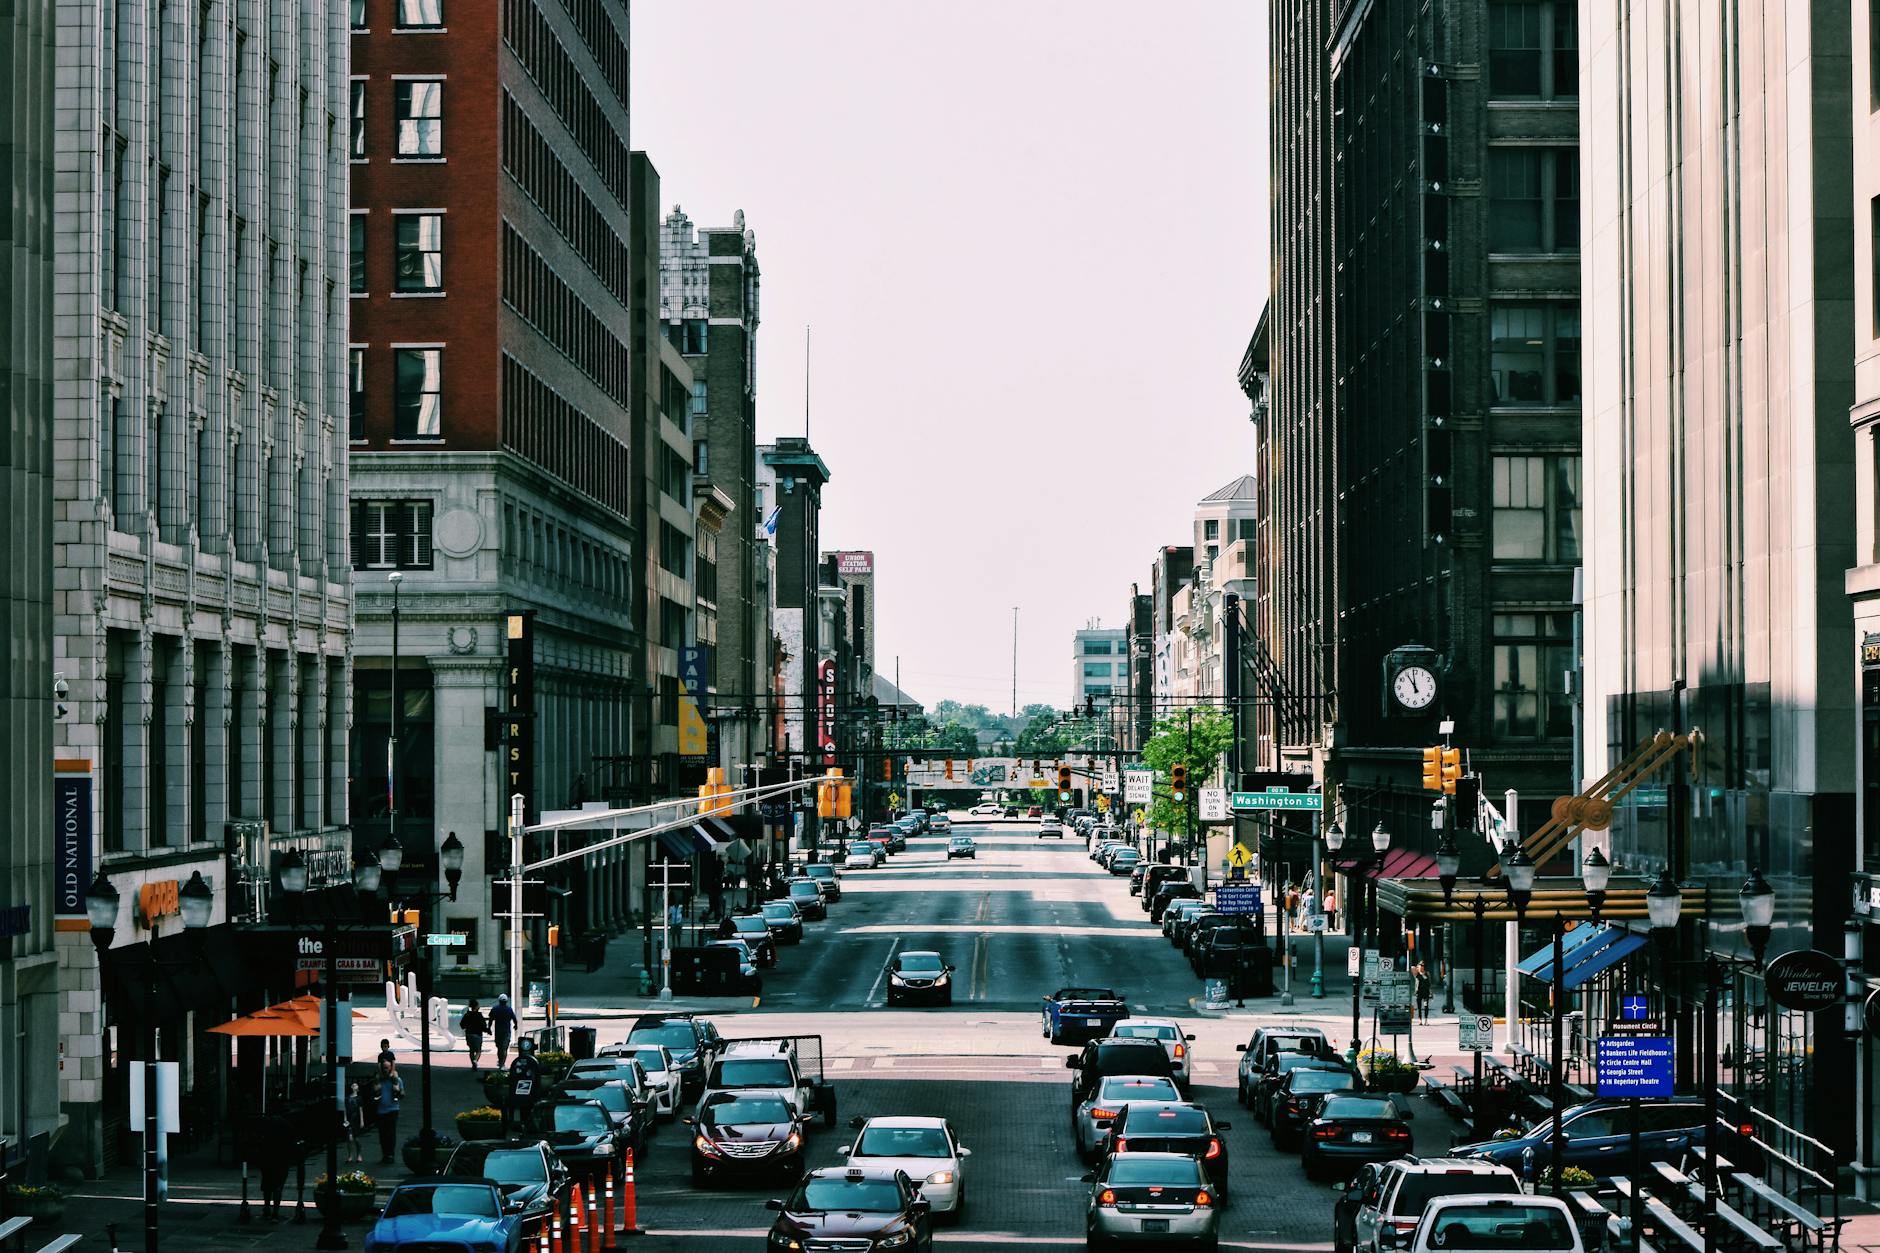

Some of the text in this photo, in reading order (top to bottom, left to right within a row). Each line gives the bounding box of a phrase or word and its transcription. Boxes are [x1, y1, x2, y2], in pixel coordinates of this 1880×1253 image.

[1128, 775, 1149, 784] WAIT
[1236, 796, 1319, 807] Washington St
[65, 787, 78, 907] OLD NATIONAL
[298, 937, 323, 954] the
[434, 936, 455, 944] Court
[1773, 964, 1823, 979] Windsor
[1783, 981, 1838, 992] JEWELRY
[1606, 1040, 1635, 1048] Artsgarden
[1606, 1069, 1627, 1077] Georgia
